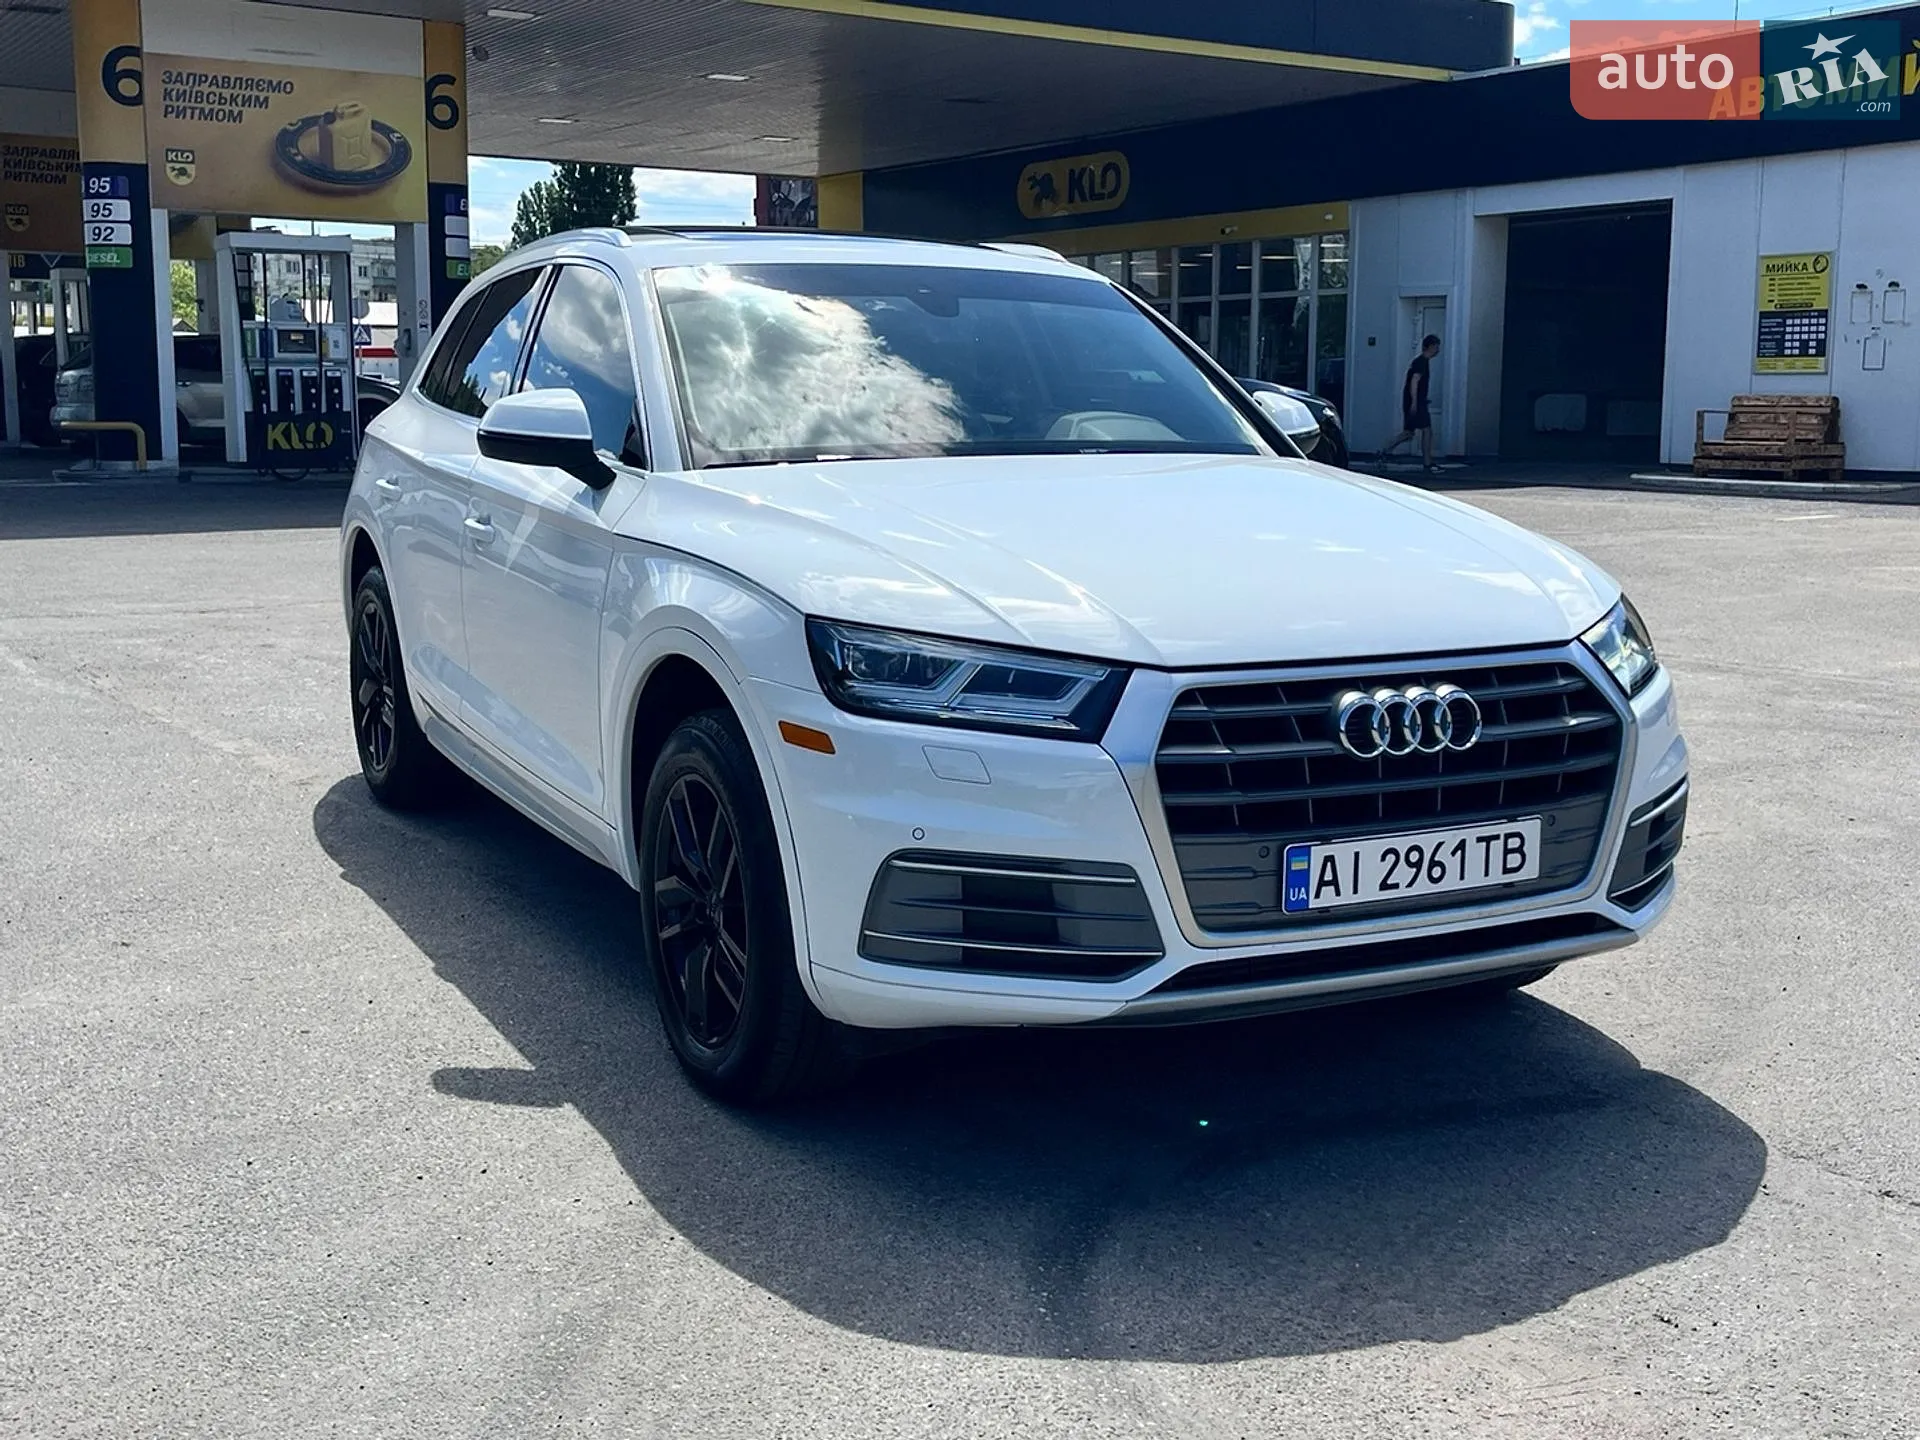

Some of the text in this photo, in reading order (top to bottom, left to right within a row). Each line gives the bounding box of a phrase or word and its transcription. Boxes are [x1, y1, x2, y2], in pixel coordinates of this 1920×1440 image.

[102, 45, 143, 106] 6
[161, 70, 294, 95] ЗАПРАВЛЯЄМО
[163, 86, 270, 110] КИЇВСЬКИМ
[426, 74, 459, 129] 6
[163, 104, 243, 124] РИТМОМ
[2, 145, 79, 161] ЗАПРАВЛЯ
[167, 150, 194, 161] KLO
[4, 170, 68, 185] РИТМОМ
[89, 177, 111, 193] 95
[1067, 162, 1121, 204] KLO
[91, 203, 113, 219] 95
[92, 226, 115, 242] 92
[1765, 260, 1808, 274] МИЙКА
[268, 422, 334, 450] KLO
[1314, 851, 1360, 900] AI
[1289, 887, 1308, 902] UA
